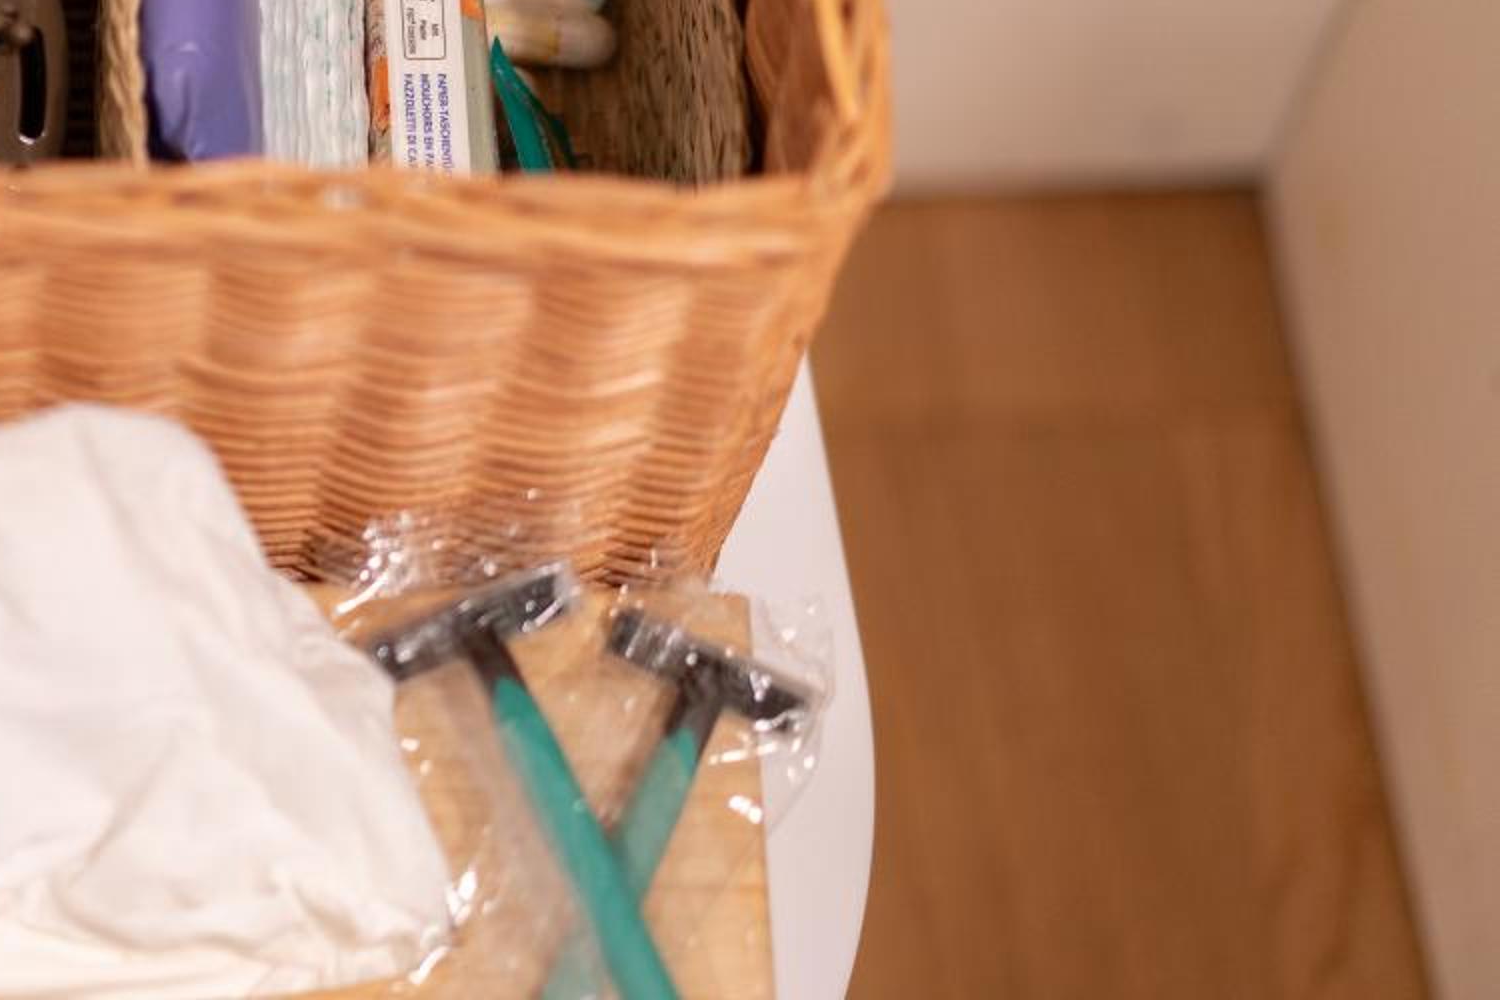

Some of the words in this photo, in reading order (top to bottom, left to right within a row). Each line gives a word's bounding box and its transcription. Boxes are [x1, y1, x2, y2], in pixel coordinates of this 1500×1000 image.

[403, 73, 417, 133] FAZZOLETTI
[420, 73, 433, 134] MOUCHOIRS
[437, 73, 453, 172] PAPIER-TASCHENTÜ
[423, 136, 434, 151] EN
